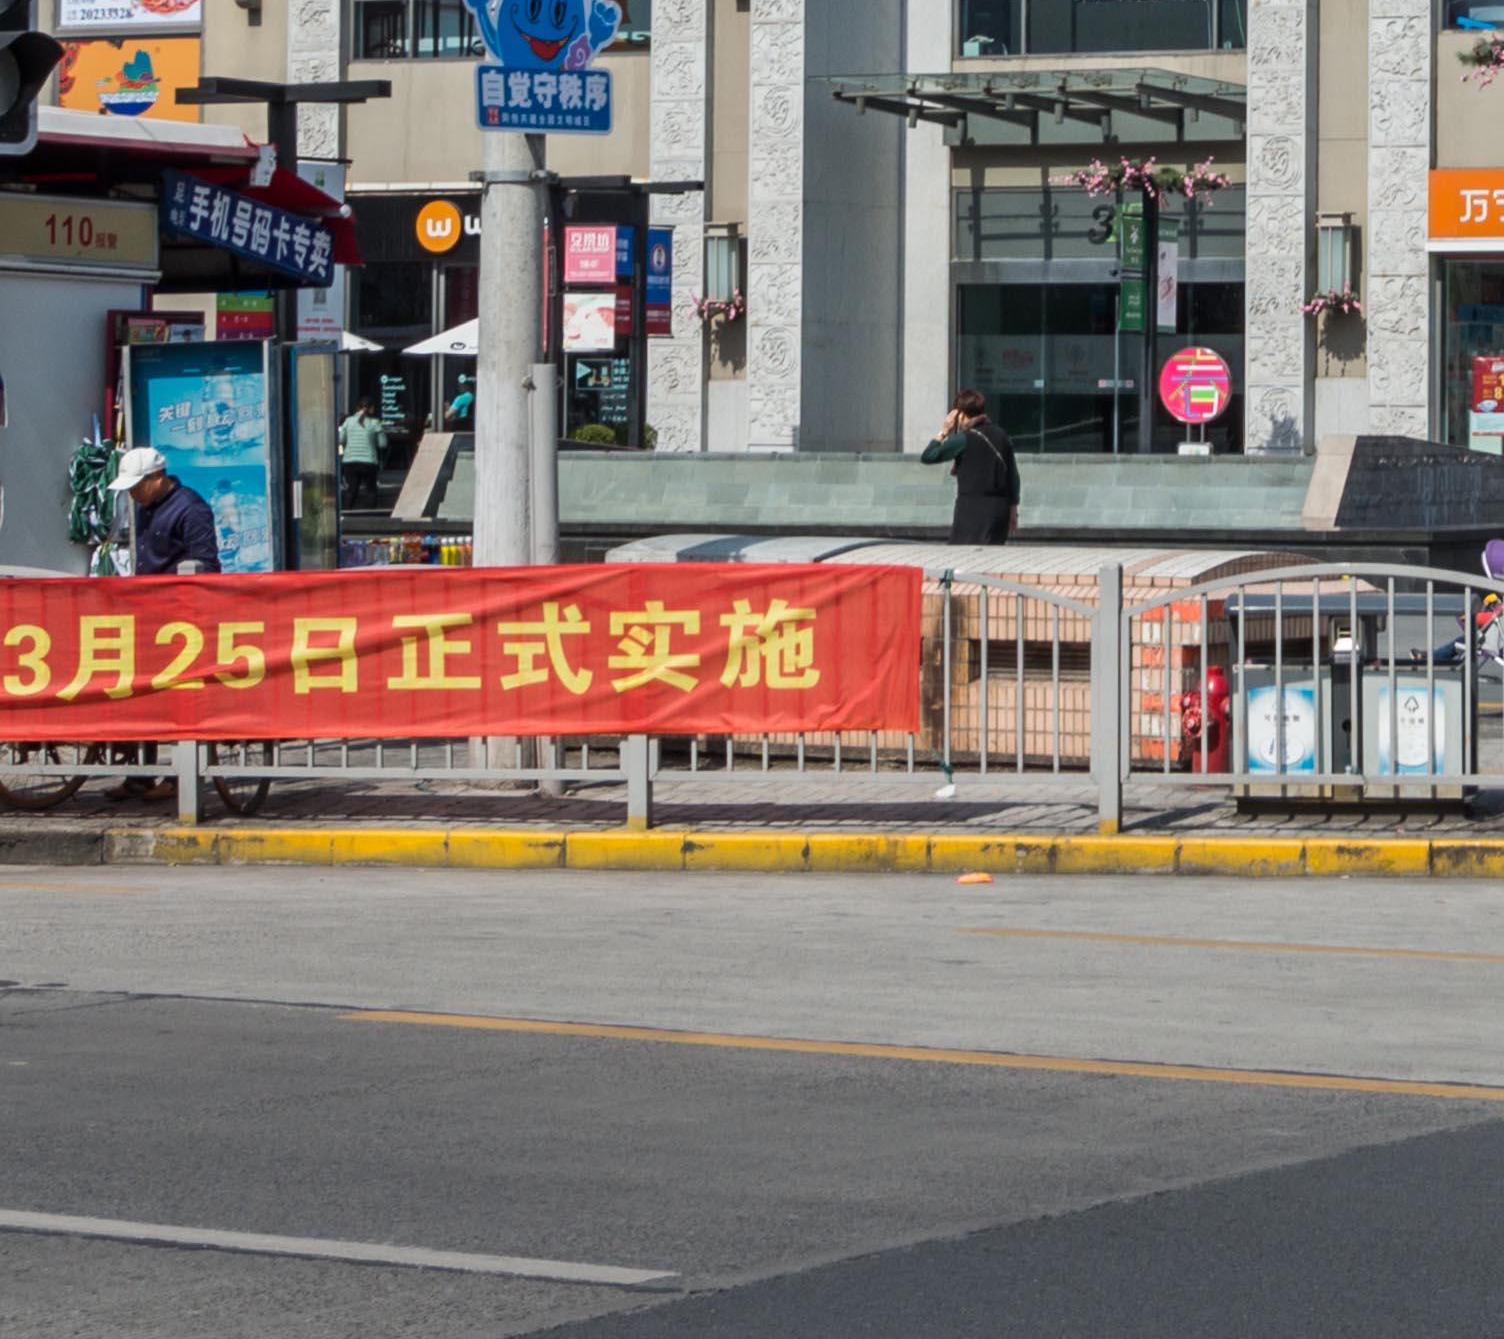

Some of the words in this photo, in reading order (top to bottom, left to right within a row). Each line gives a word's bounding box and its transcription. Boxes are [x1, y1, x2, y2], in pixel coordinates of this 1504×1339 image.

[481, 69, 608, 111] 自觉守秩序
[45, 213, 94, 247] 110
[188, 184, 333, 278] 手机号码卡专卖
